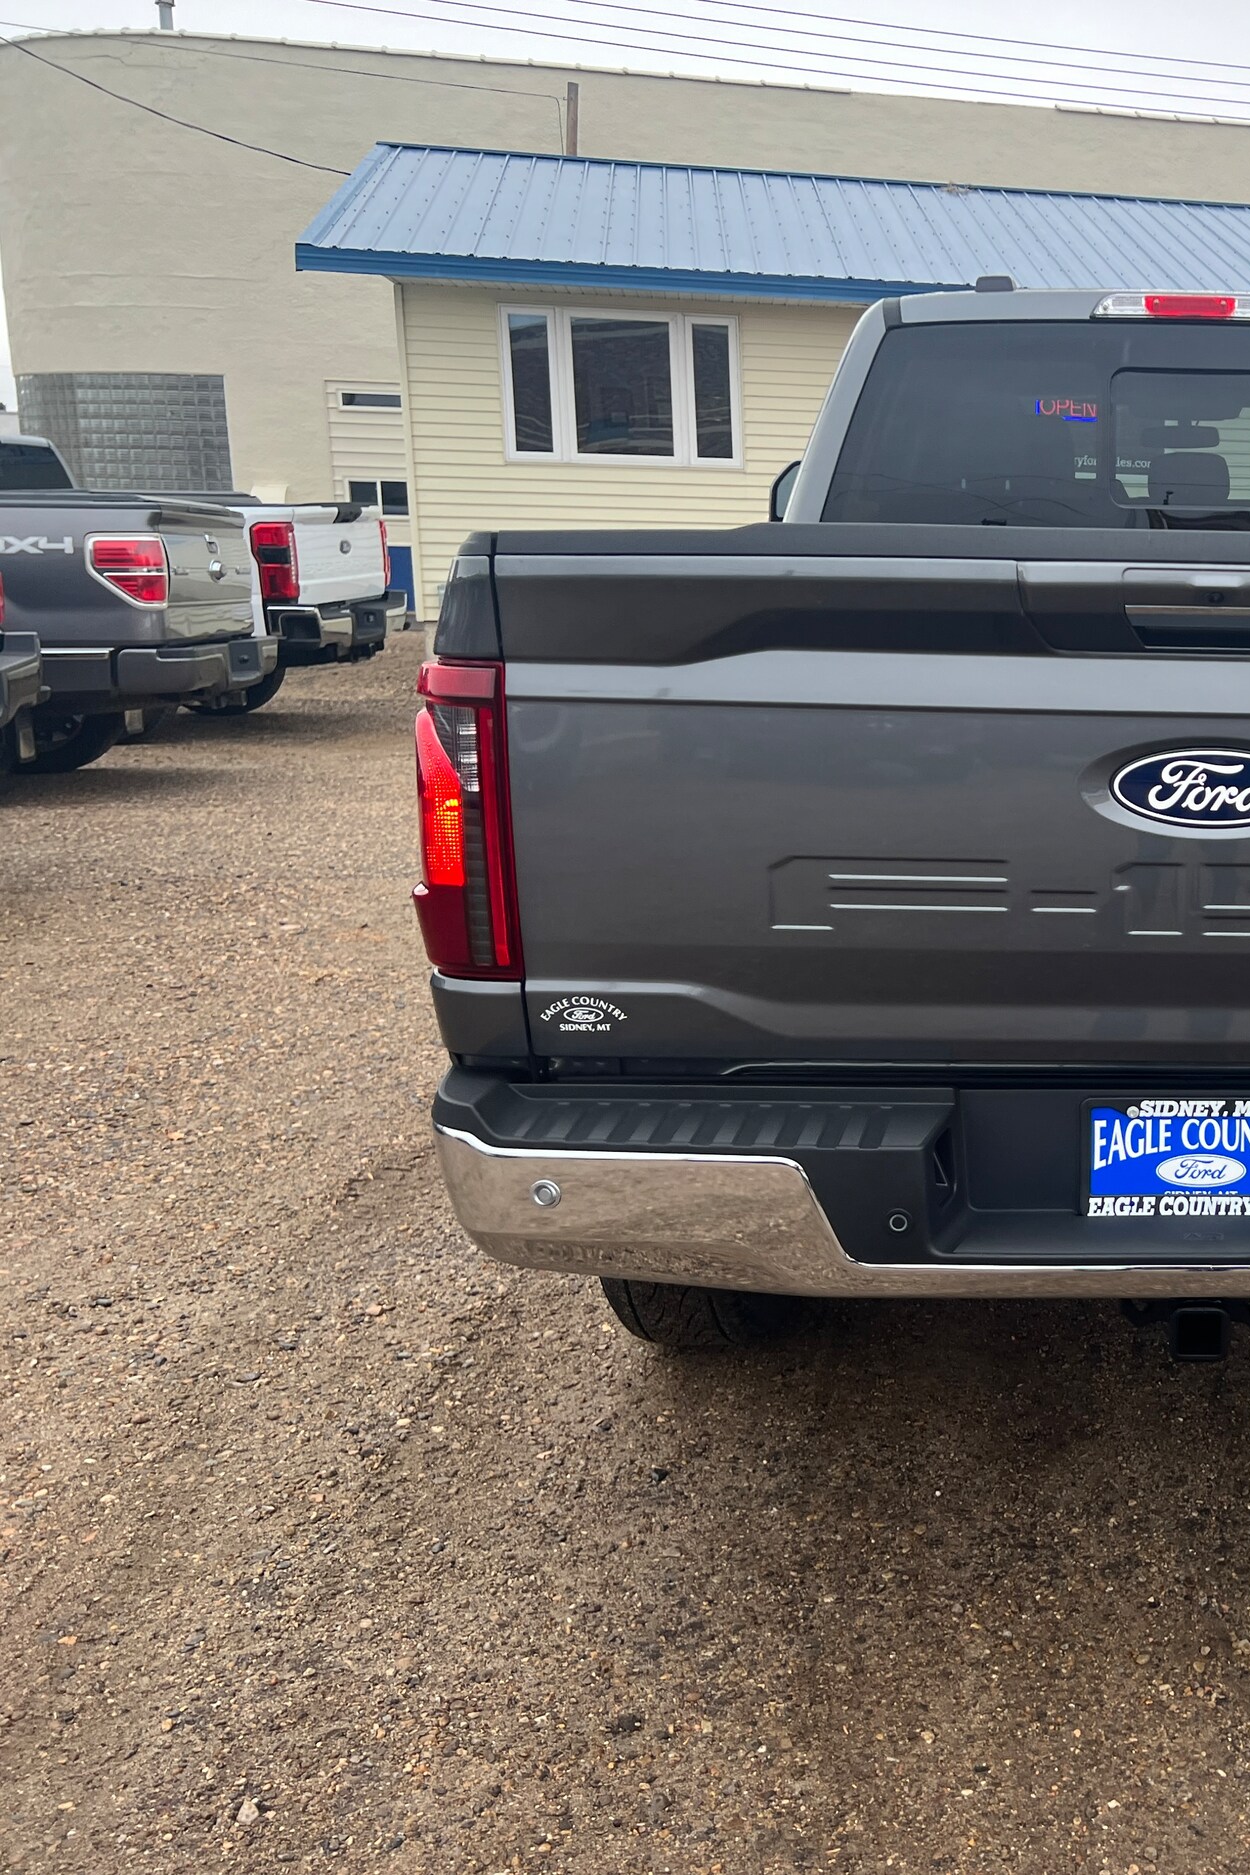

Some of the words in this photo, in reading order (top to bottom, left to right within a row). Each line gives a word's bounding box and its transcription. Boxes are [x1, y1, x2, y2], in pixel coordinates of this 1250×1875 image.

[1040, 400, 1097, 417] OPEN
[540, 998, 570, 1021] EAGLE
[572, 996, 628, 1021] COUNTRY
[571, 1009, 596, 1020] Ford
[559, 1023, 595, 1032] SIDNEY,
[597, 1023, 611, 1031] MT
[1093, 1119, 1171, 1171] EAGLE
[1174, 1158, 1226, 1180] Ford
[1087, 1197, 1155, 1216] EAGLE
